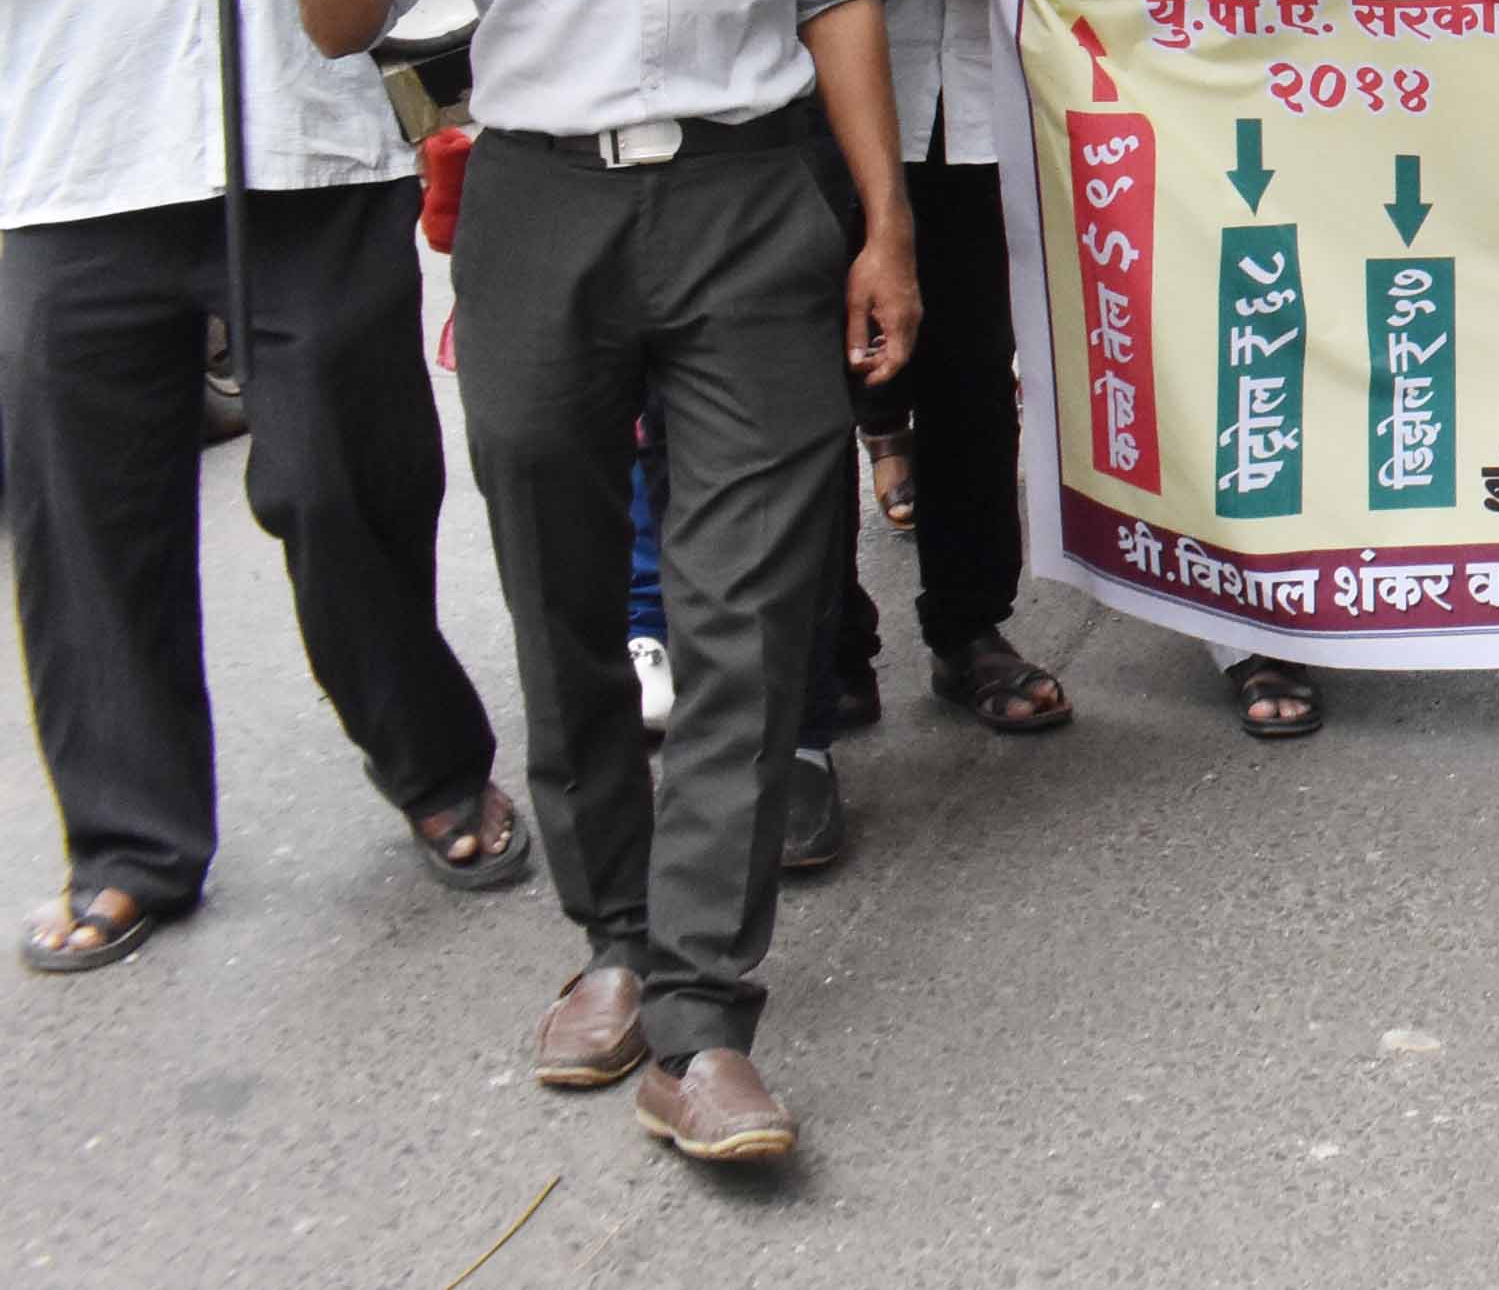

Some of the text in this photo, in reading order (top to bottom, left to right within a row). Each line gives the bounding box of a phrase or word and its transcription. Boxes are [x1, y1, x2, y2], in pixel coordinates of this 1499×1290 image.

[1268, 62, 1430, 112] २०१४
[1090, 282, 1133, 364] तेल
[1219, 376, 1298, 493] पेट्रोल
[1376, 376, 1441, 490] डिझेल
[1333, 549, 1454, 616] शंकर
